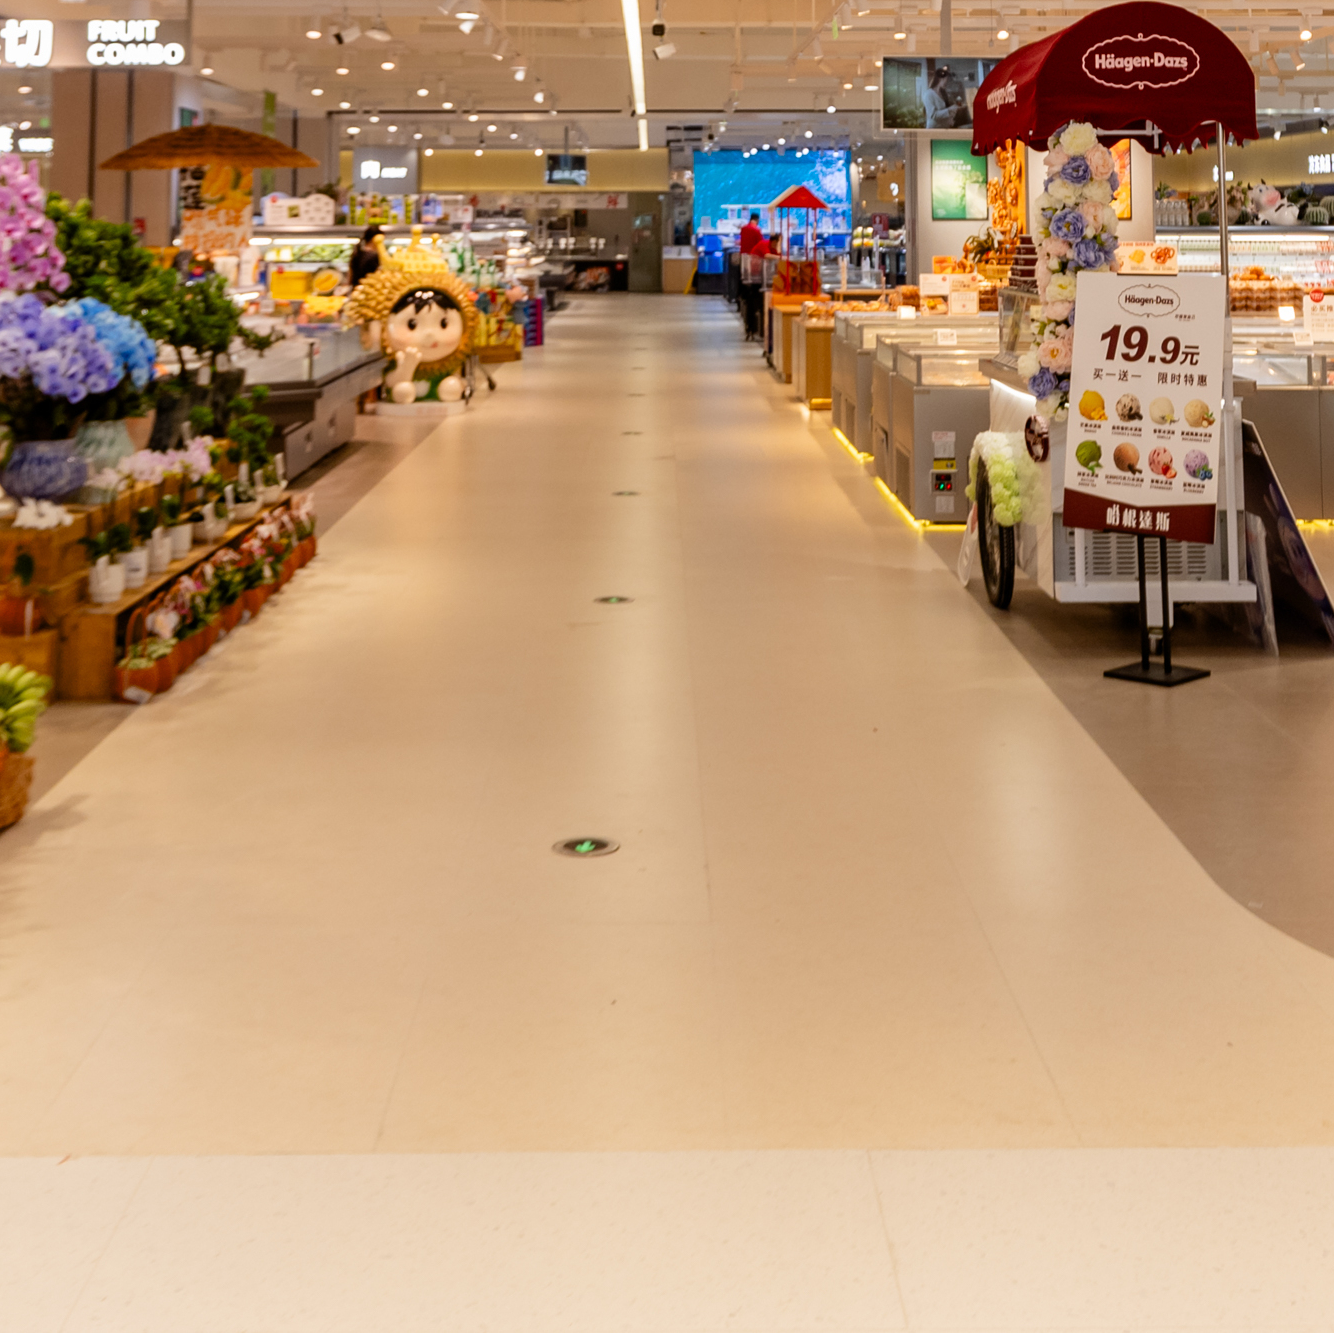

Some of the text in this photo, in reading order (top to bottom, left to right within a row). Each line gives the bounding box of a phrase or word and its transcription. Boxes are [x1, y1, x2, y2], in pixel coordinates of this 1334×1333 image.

[87, 19, 160, 42] FRUIT
[86, 42, 186, 66] COMBO
[1093, 368, 1208, 387] 买一送一 限时特惠
